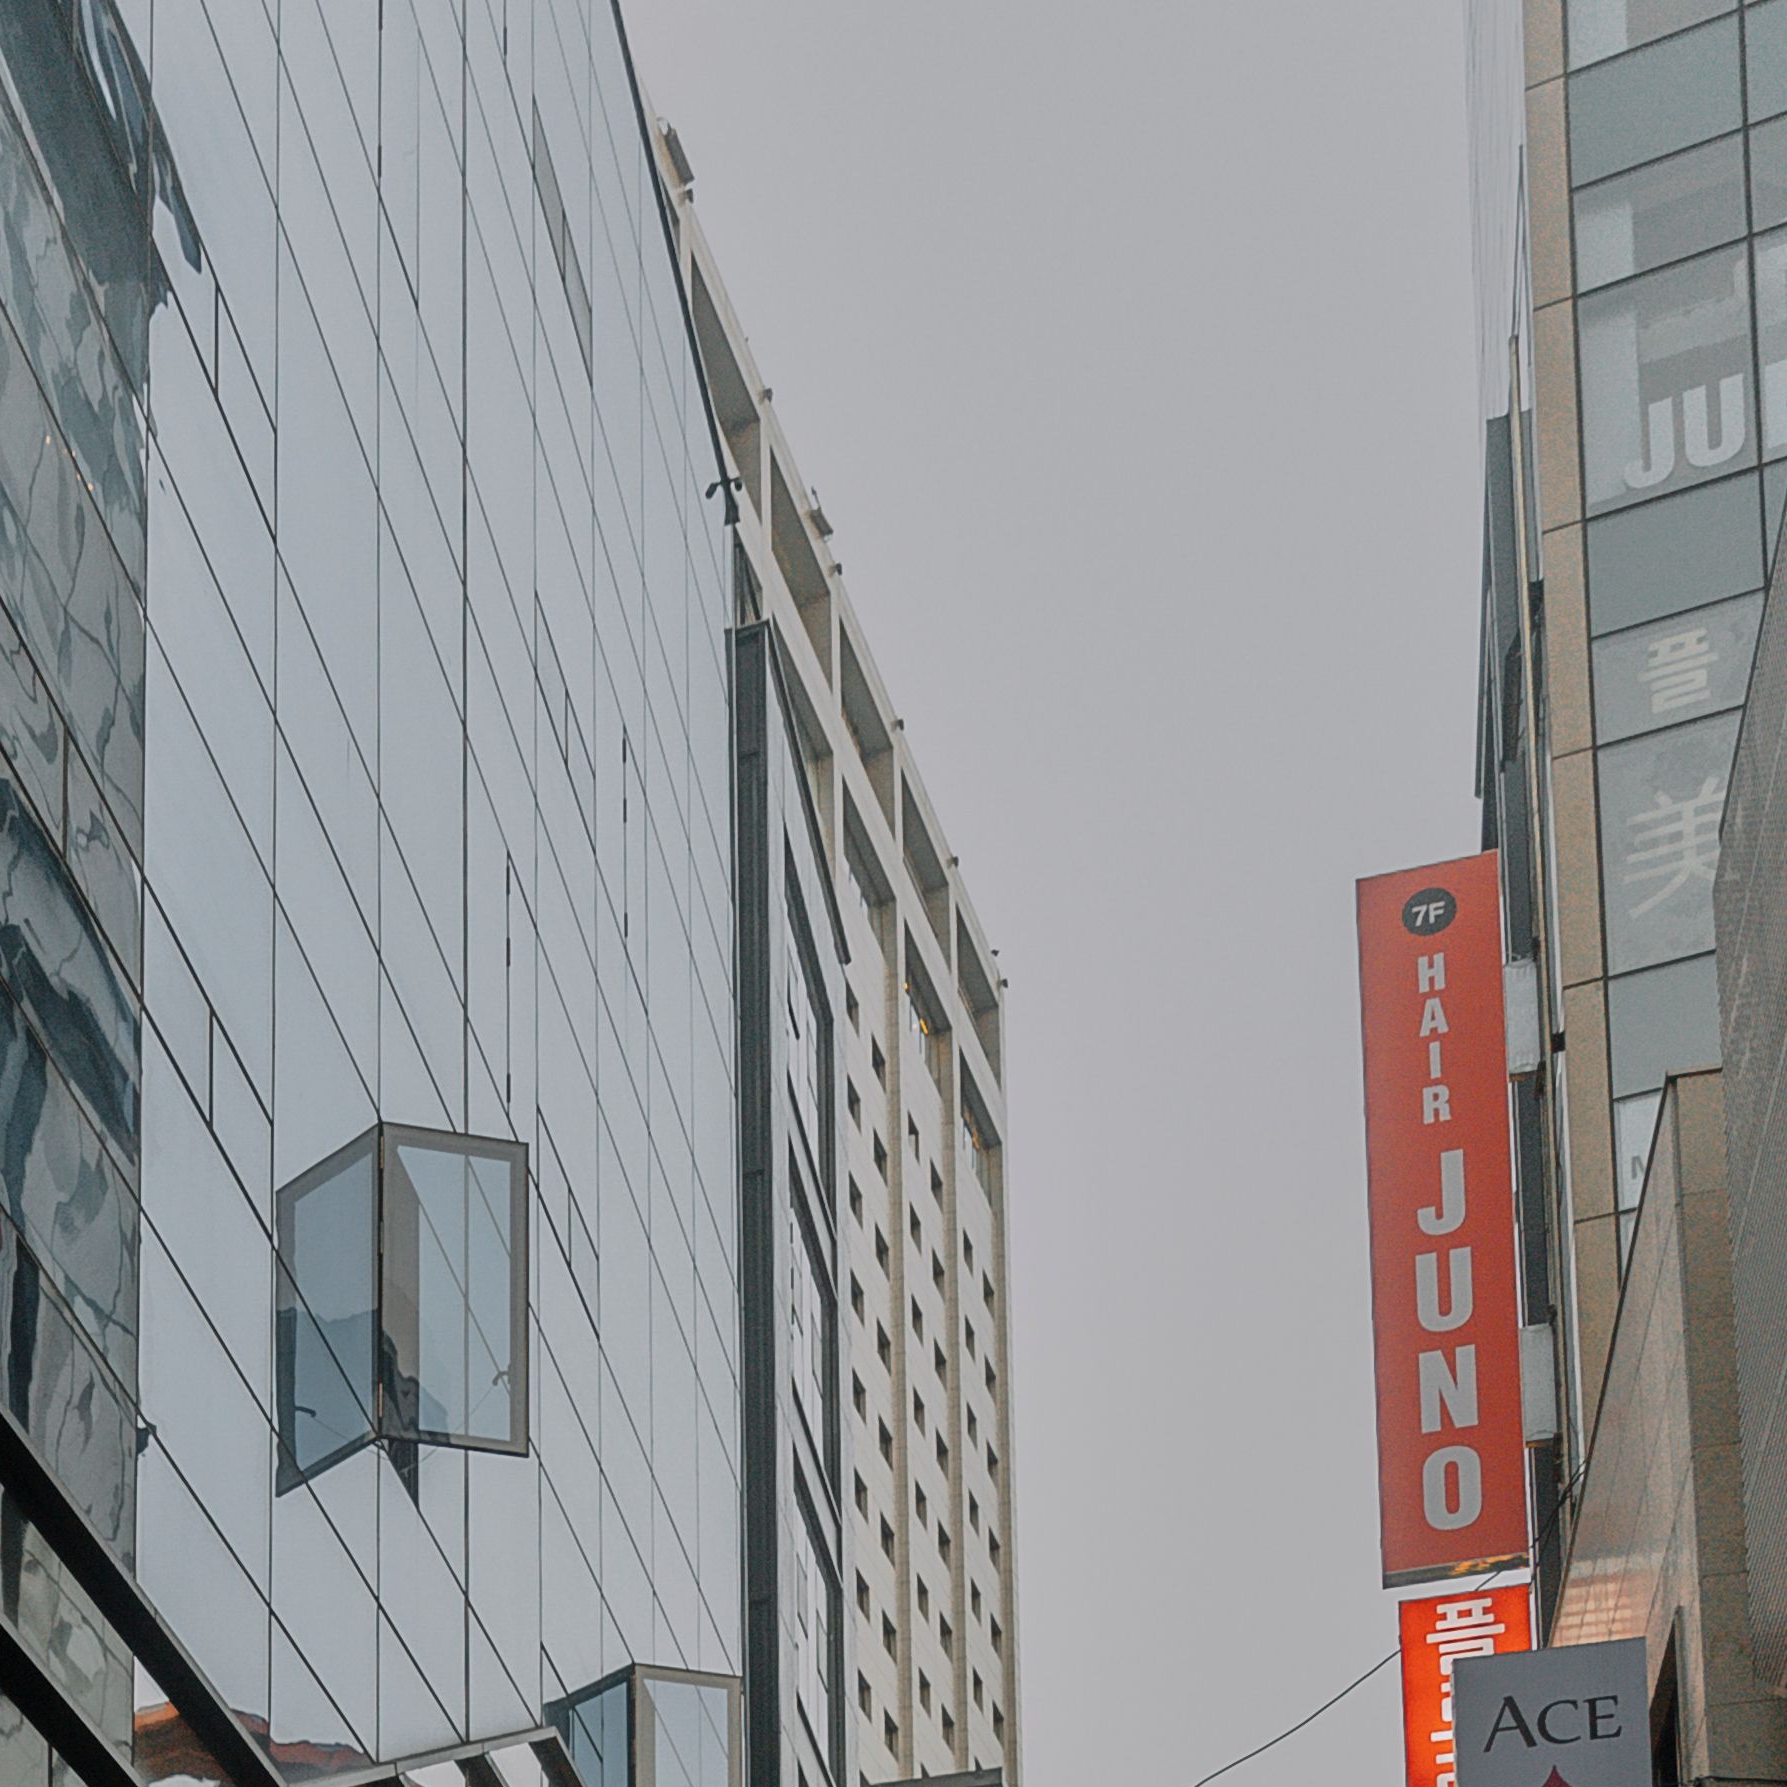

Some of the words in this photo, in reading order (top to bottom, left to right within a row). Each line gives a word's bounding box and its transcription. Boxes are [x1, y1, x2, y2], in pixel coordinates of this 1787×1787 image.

[1412, 900, 1446, 927] 7F
[1417, 951, 1452, 1125] HAIR
[1415, 1148, 1482, 1531] JUNO
[1483, 1695, 1623, 1753] ACE
